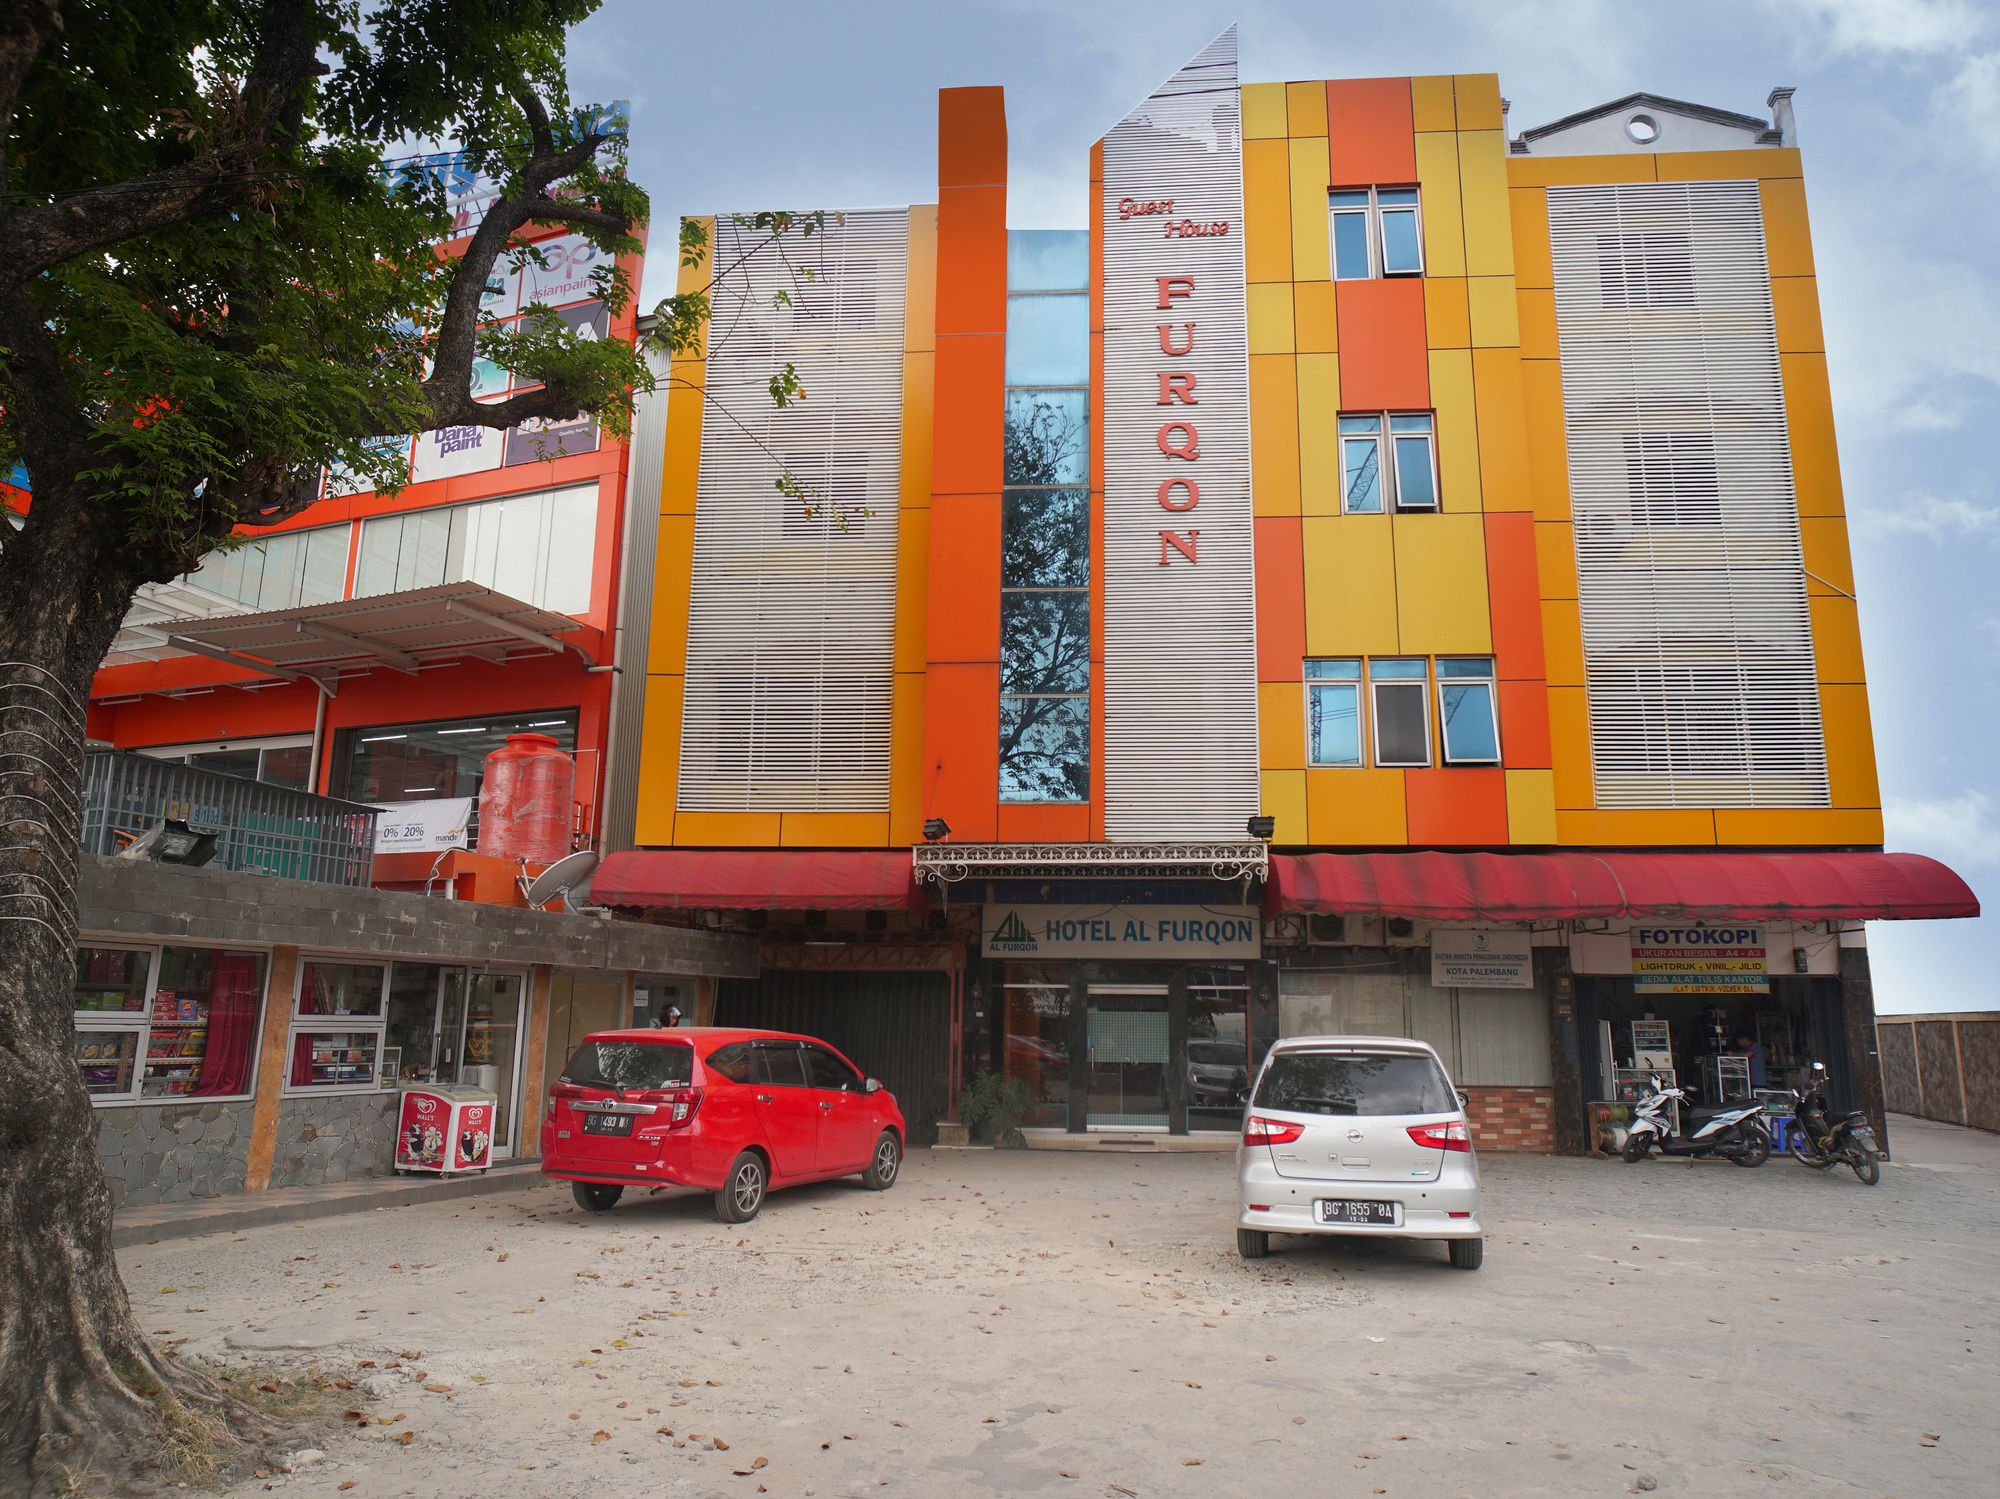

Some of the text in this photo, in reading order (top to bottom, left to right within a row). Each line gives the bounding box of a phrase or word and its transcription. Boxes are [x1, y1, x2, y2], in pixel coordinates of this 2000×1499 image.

[1118, 198, 1174, 220] Guest
[1164, 219, 1230, 238] House
[529, 276, 603, 300] asianpaint
[1156, 276, 1201, 566] FURQON
[435, 425, 477, 443] Dana
[440, 432, 482, 458] paint
[384, 826, 424, 837] 0% 20%
[1046, 920, 1252, 945] HOTEL AL FURQON
[1639, 929, 1758, 944] FOTOKOPI
[989, 943, 1038, 951] AL FURQON
[1640, 950, 1681, 958] UKURAN
[1446, 967, 1519, 976] KOTA PALEMBANG
[1739, 962, 1762, 970] JILID
[1641, 975, 1763, 983] SEDIA ALAT TULIS KANTOR
[587, 1114, 598, 1126] BG
[600, 1116, 617, 1127] 1493
[1325, 1202, 1339, 1215] BG
[1346, 1202, 1370, 1216] 1655
